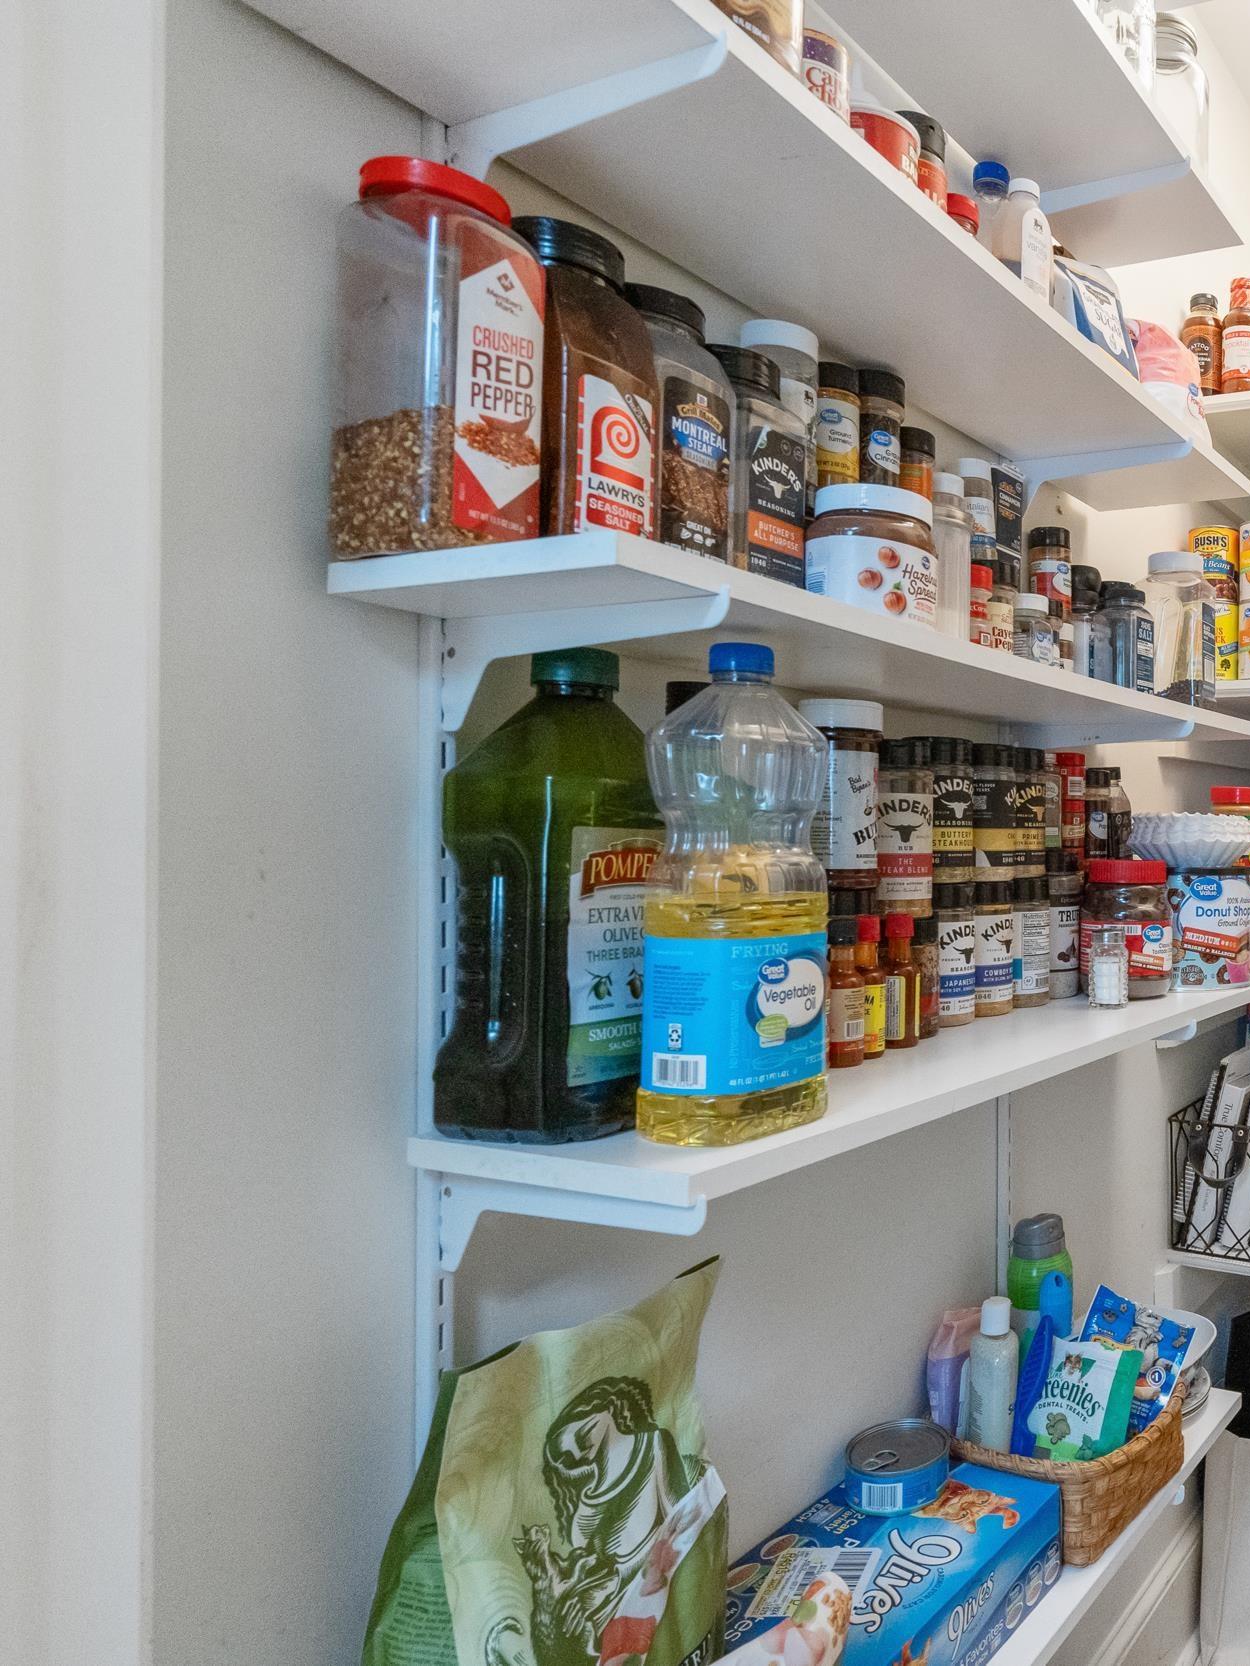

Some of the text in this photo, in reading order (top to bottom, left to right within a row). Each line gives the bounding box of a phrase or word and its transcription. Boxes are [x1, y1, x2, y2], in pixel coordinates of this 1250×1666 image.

[472, 325, 534, 359] CRUSHED
[471, 349, 534, 389] RED
[471, 382, 534, 418] PEPPER
[671, 415, 728, 452] MONTREAL
[828, 428, 852, 439] Ground
[688, 438, 713, 457] STEAK
[588, 497, 644, 525] SEASONED
[757, 498, 796, 518] SEASONING
[605, 515, 630, 531] SALT
[686, 520, 699, 533] GREAT
[758, 520, 796, 541] BUTCHER'S
[754, 530, 800, 552] ALL PURPOSE
[1194, 534, 1228, 550] BUSH'S
[1207, 560, 1231, 571] Beans
[1138, 628, 1153, 641] SALT
[940, 831, 972, 839] BUTTERY
[898, 857, 914, 865] THE
[878, 865, 929, 874] STEAK BLEND
[1193, 882, 1218, 893] Great
[1199, 889, 1218, 897] Value
[587, 905, 630, 925] EXTRA
[1195, 905, 1231, 918] Donut
[1217, 918, 1239, 928] Ground
[603, 927, 640, 944] OLIVE
[1185, 931, 1221, 946] MEDIUM
[730, 942, 789, 959] FRYING
[1182, 943, 1205, 952] BRIGHT
[586, 950, 622, 964] THREE
[762, 964, 785, 975] Great
[984, 968, 1009, 977] COWBOY
[764, 984, 817, 1004] Vegetable
[804, 996, 817, 1012] Oil
[940, 1004, 951, 1012] 46
[588, 1023, 636, 1042] SMOOTH
[1217, 1103, 1234, 1122] True
[1038, 1401, 1088, 1423] DENTAL TREATS
[850, 1528, 963, 1633] 9Lives
[947, 1571, 995, 1661] 9Lives
